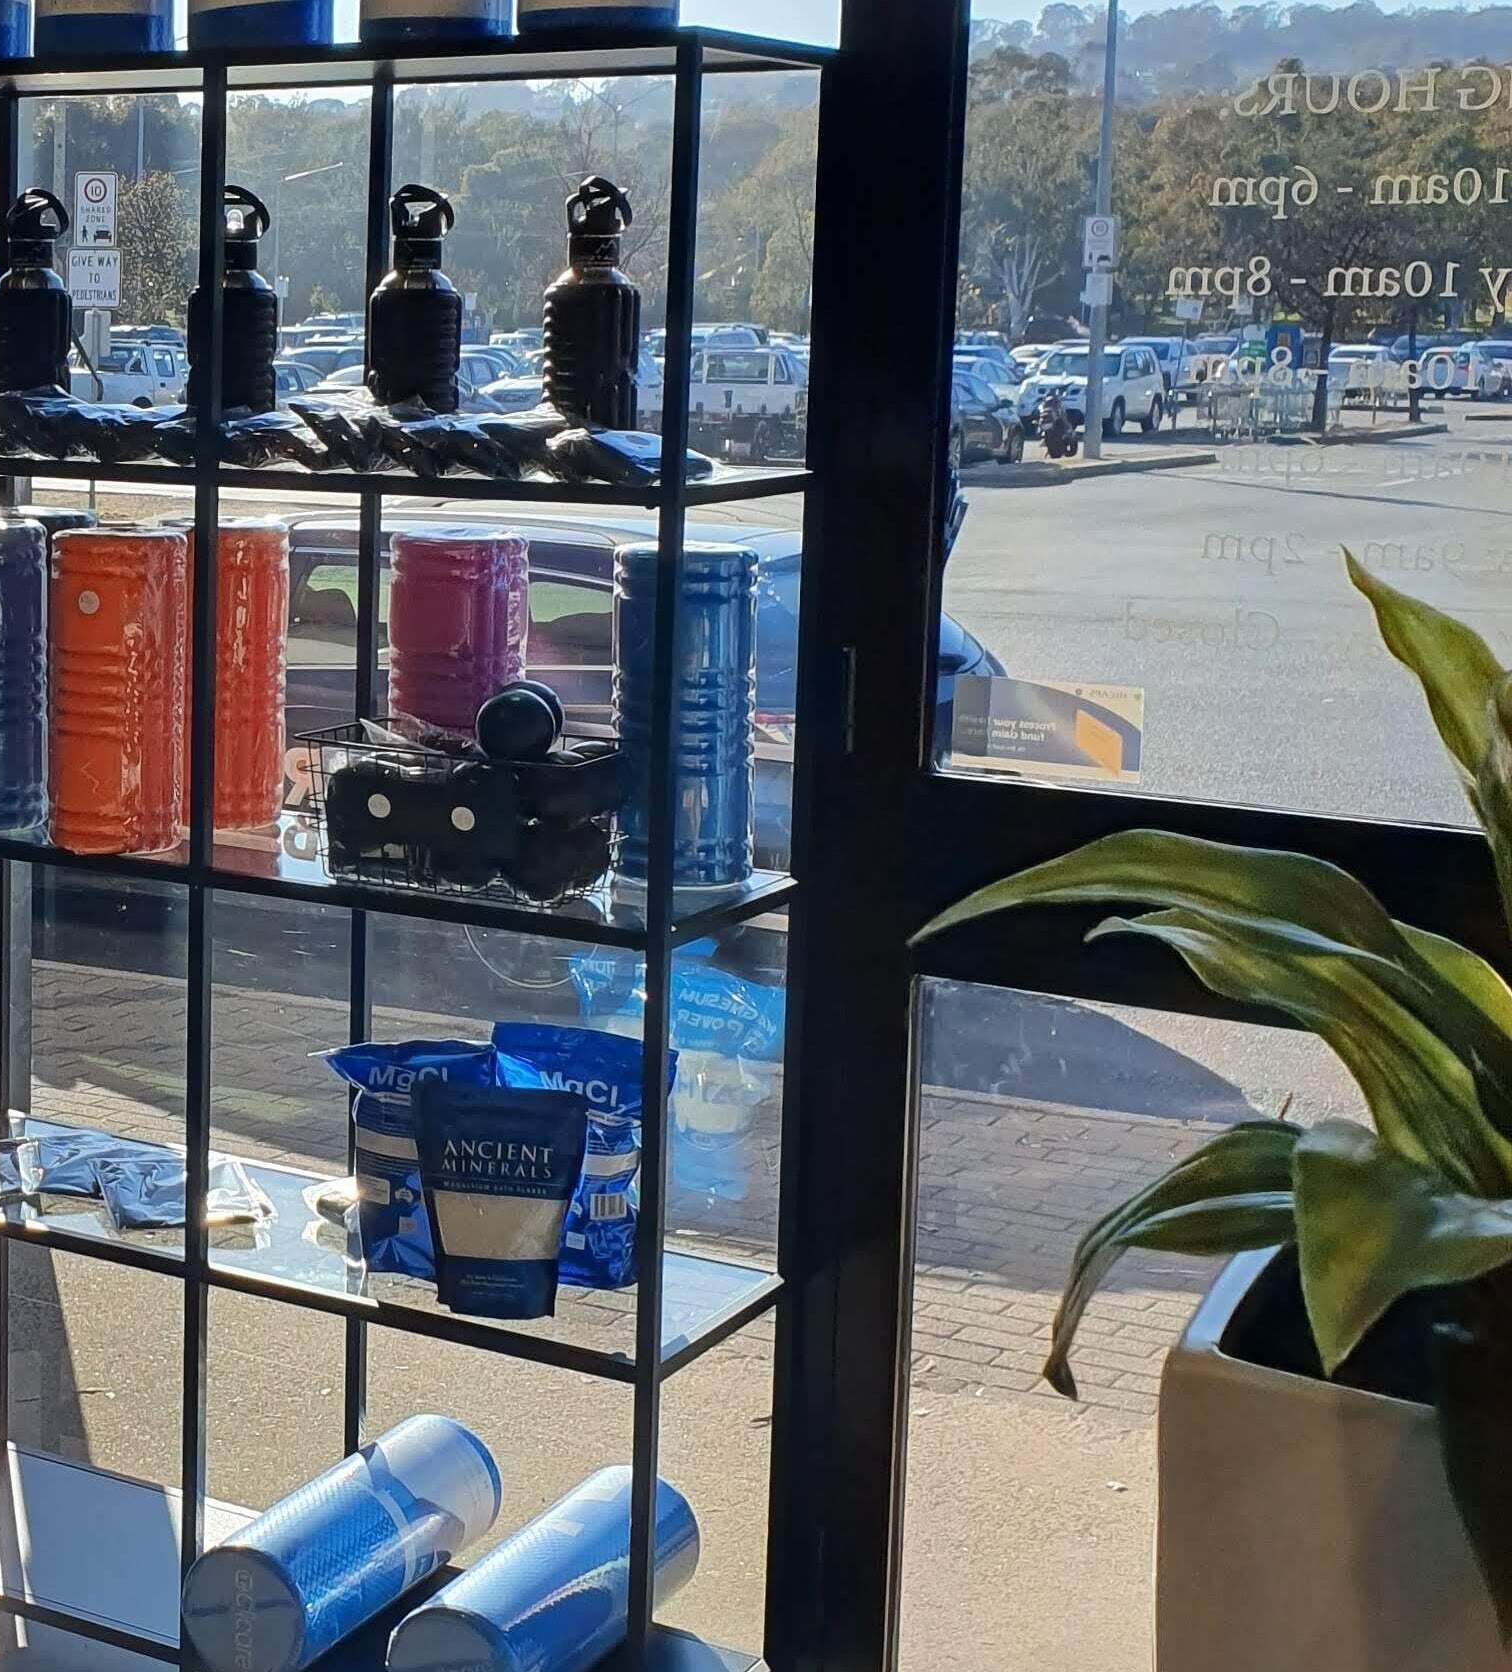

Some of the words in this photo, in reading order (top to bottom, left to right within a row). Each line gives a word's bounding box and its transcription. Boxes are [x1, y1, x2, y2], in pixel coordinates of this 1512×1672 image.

[90, 185, 101, 197] 10
[86, 215, 105, 223] ZONE
[72, 256, 93, 267] GIVE
[98, 256, 118, 267] WAY
[88, 273, 101, 284] TO
[72, 290, 117, 301] PEDESTRIANS
[443, 1139, 554, 1164] ANCIENT
[442, 1159, 552, 1179] MINERALS
